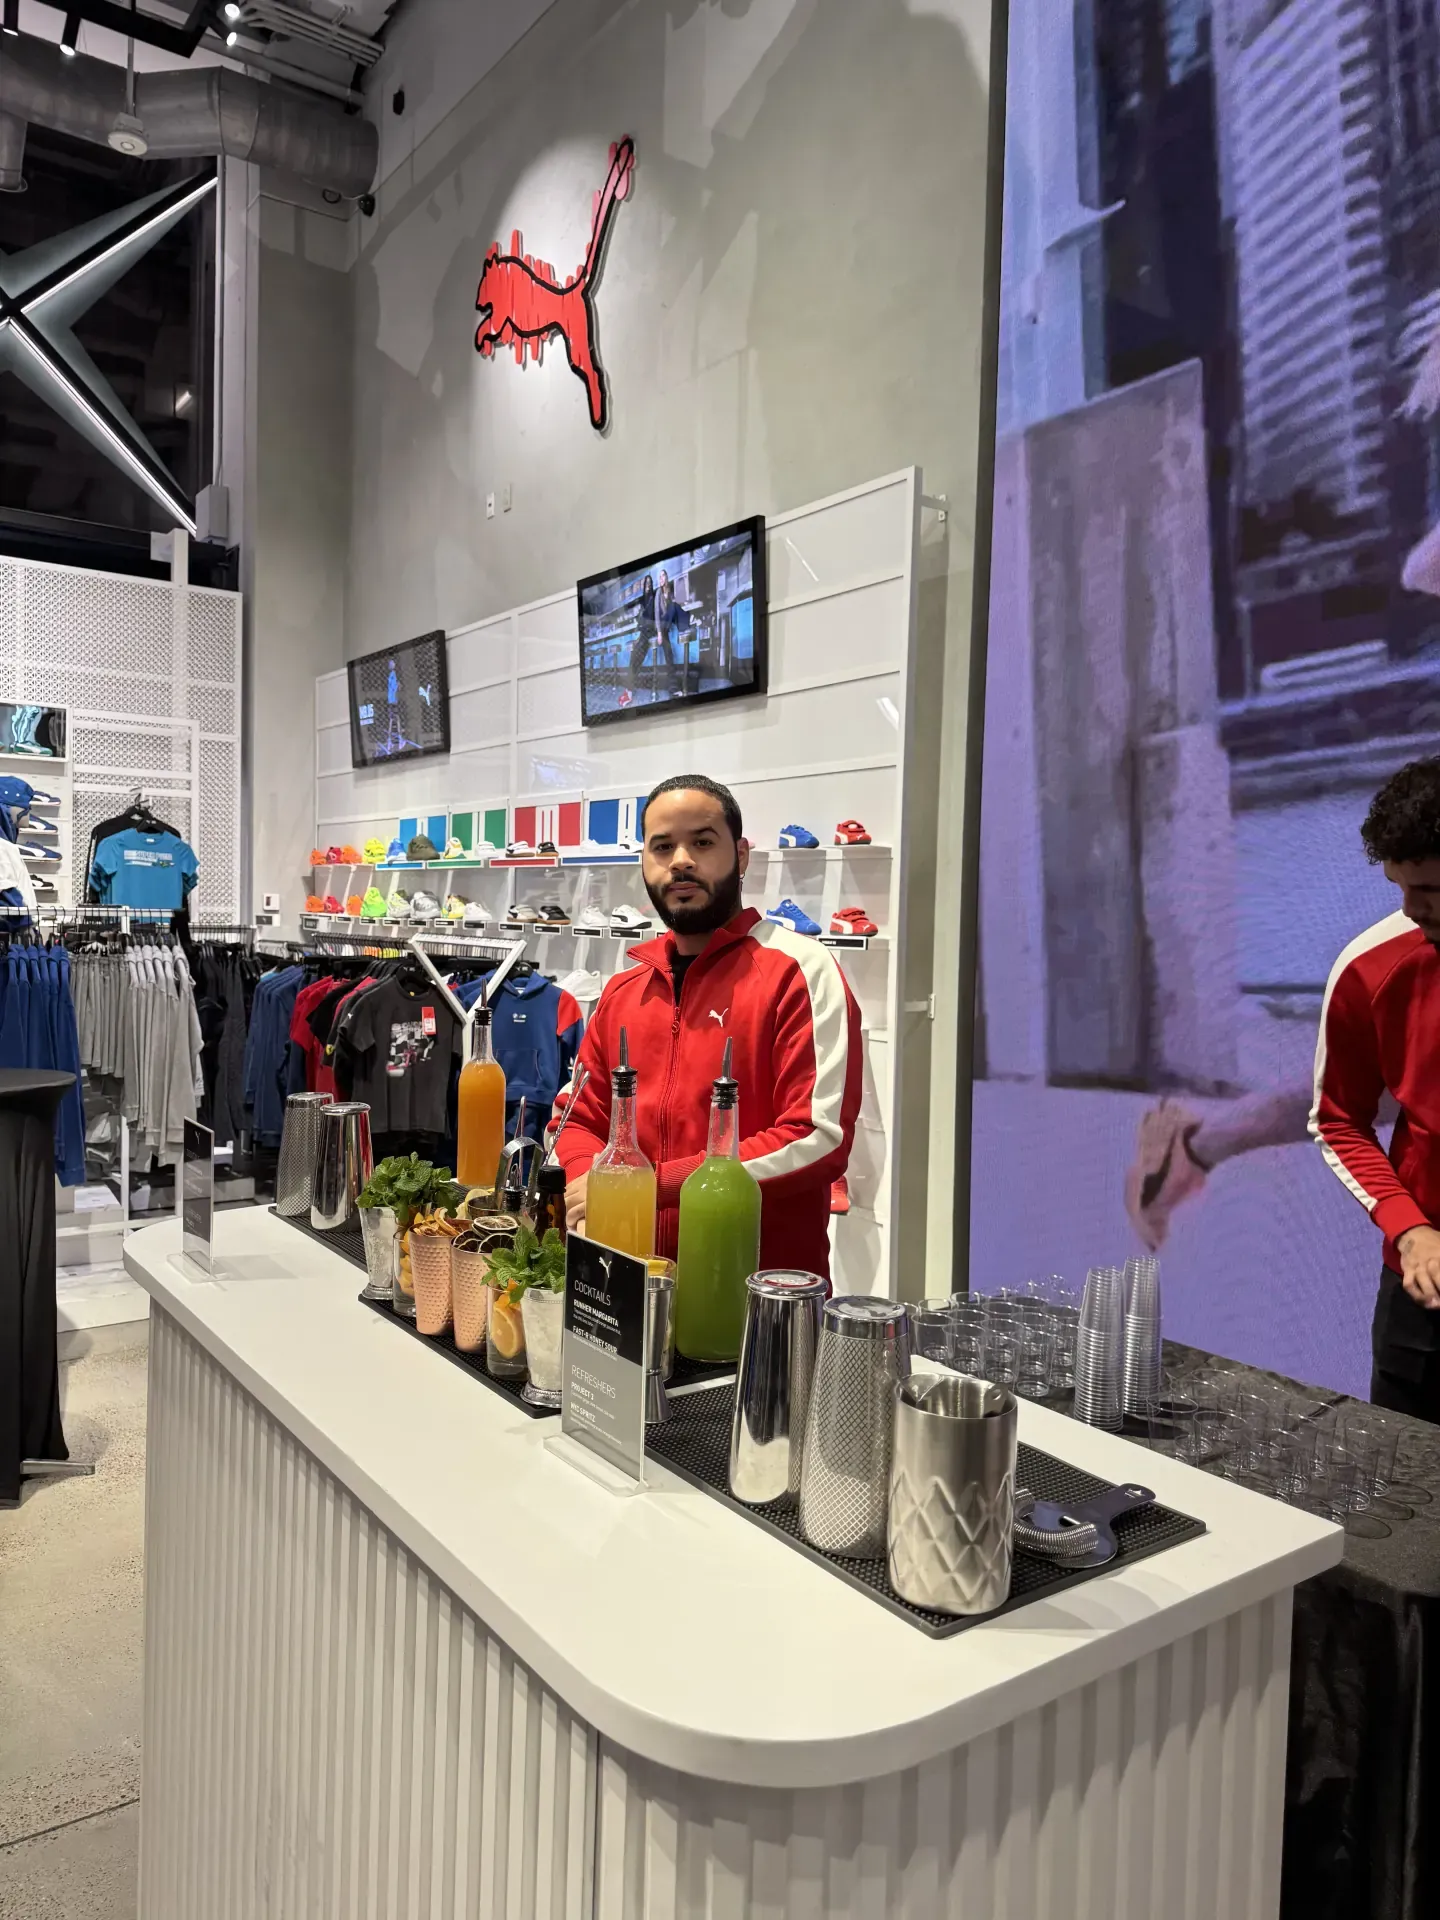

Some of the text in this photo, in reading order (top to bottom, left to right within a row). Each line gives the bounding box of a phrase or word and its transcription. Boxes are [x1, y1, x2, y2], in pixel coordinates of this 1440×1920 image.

[574, 1280, 611, 1306] COCKTAILS
[592, 1308, 619, 1327] MARGARITA
[571, 1364, 616, 1399] REFRESHERS
[571, 1381, 591, 1398] PROJECT
[579, 1407, 596, 1423] SPRITZ
